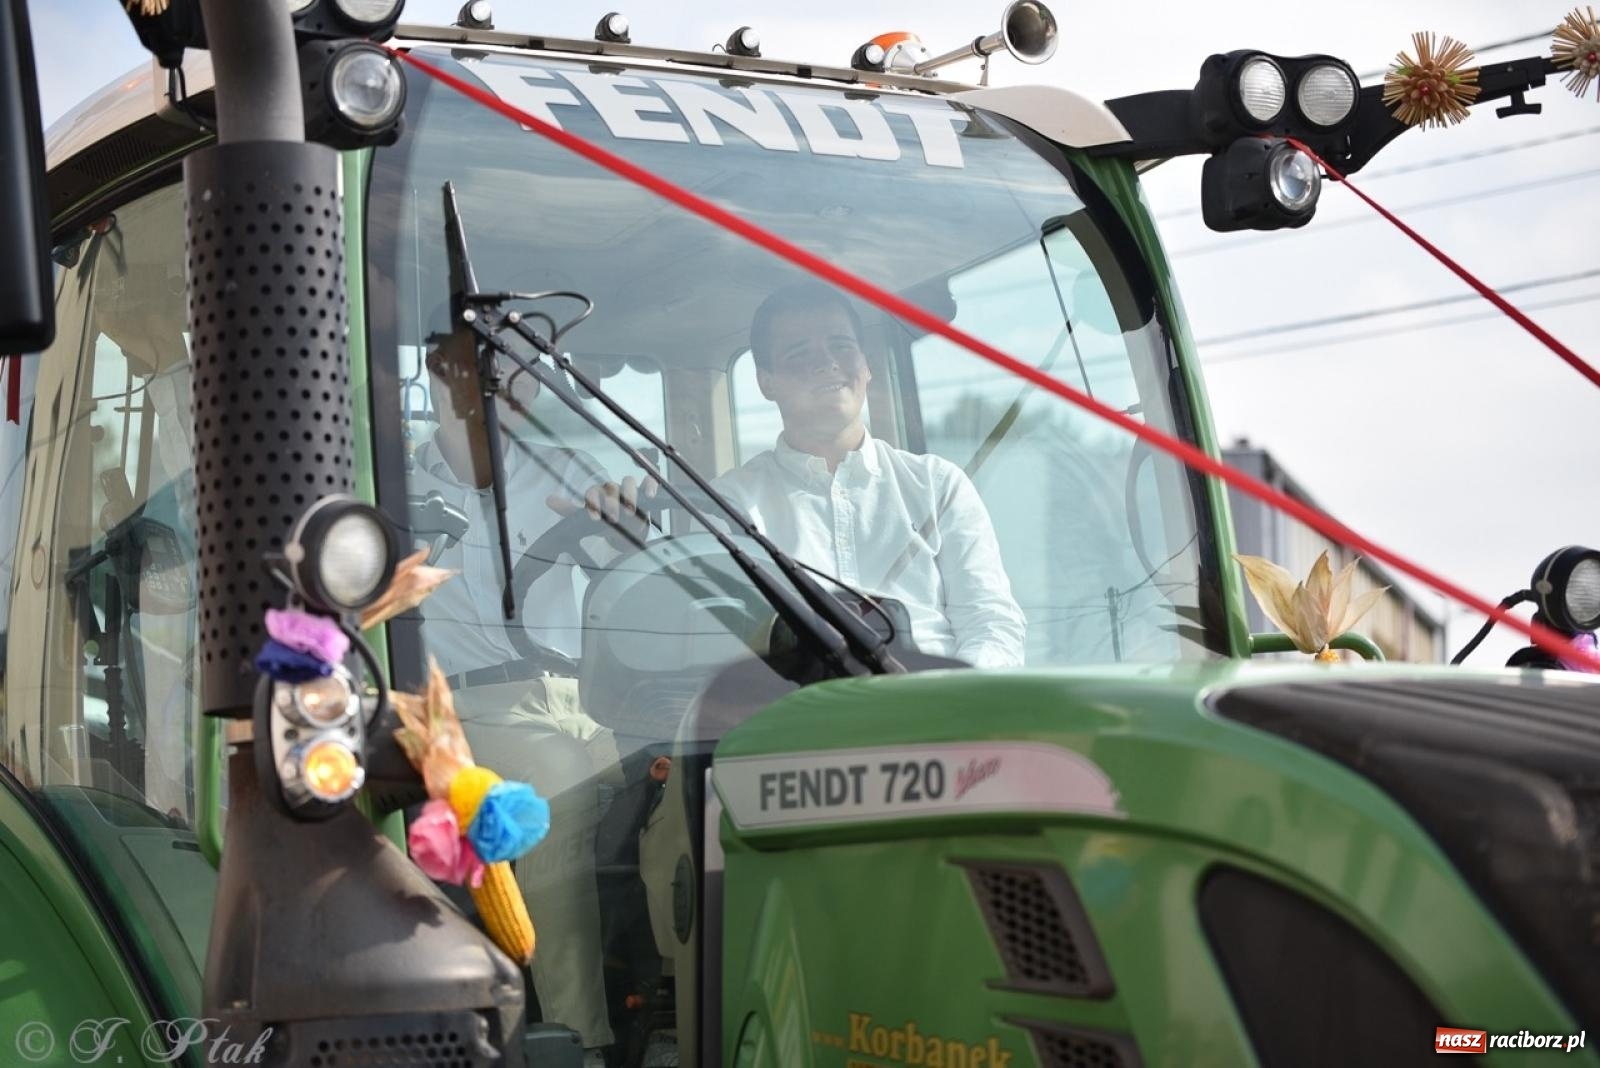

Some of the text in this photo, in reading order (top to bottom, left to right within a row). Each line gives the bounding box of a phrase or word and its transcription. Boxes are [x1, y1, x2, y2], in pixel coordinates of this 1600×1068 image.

[458, 62, 969, 169] FENDT
[758, 765, 867, 811] FENDT
[880, 759, 945, 804] 720
